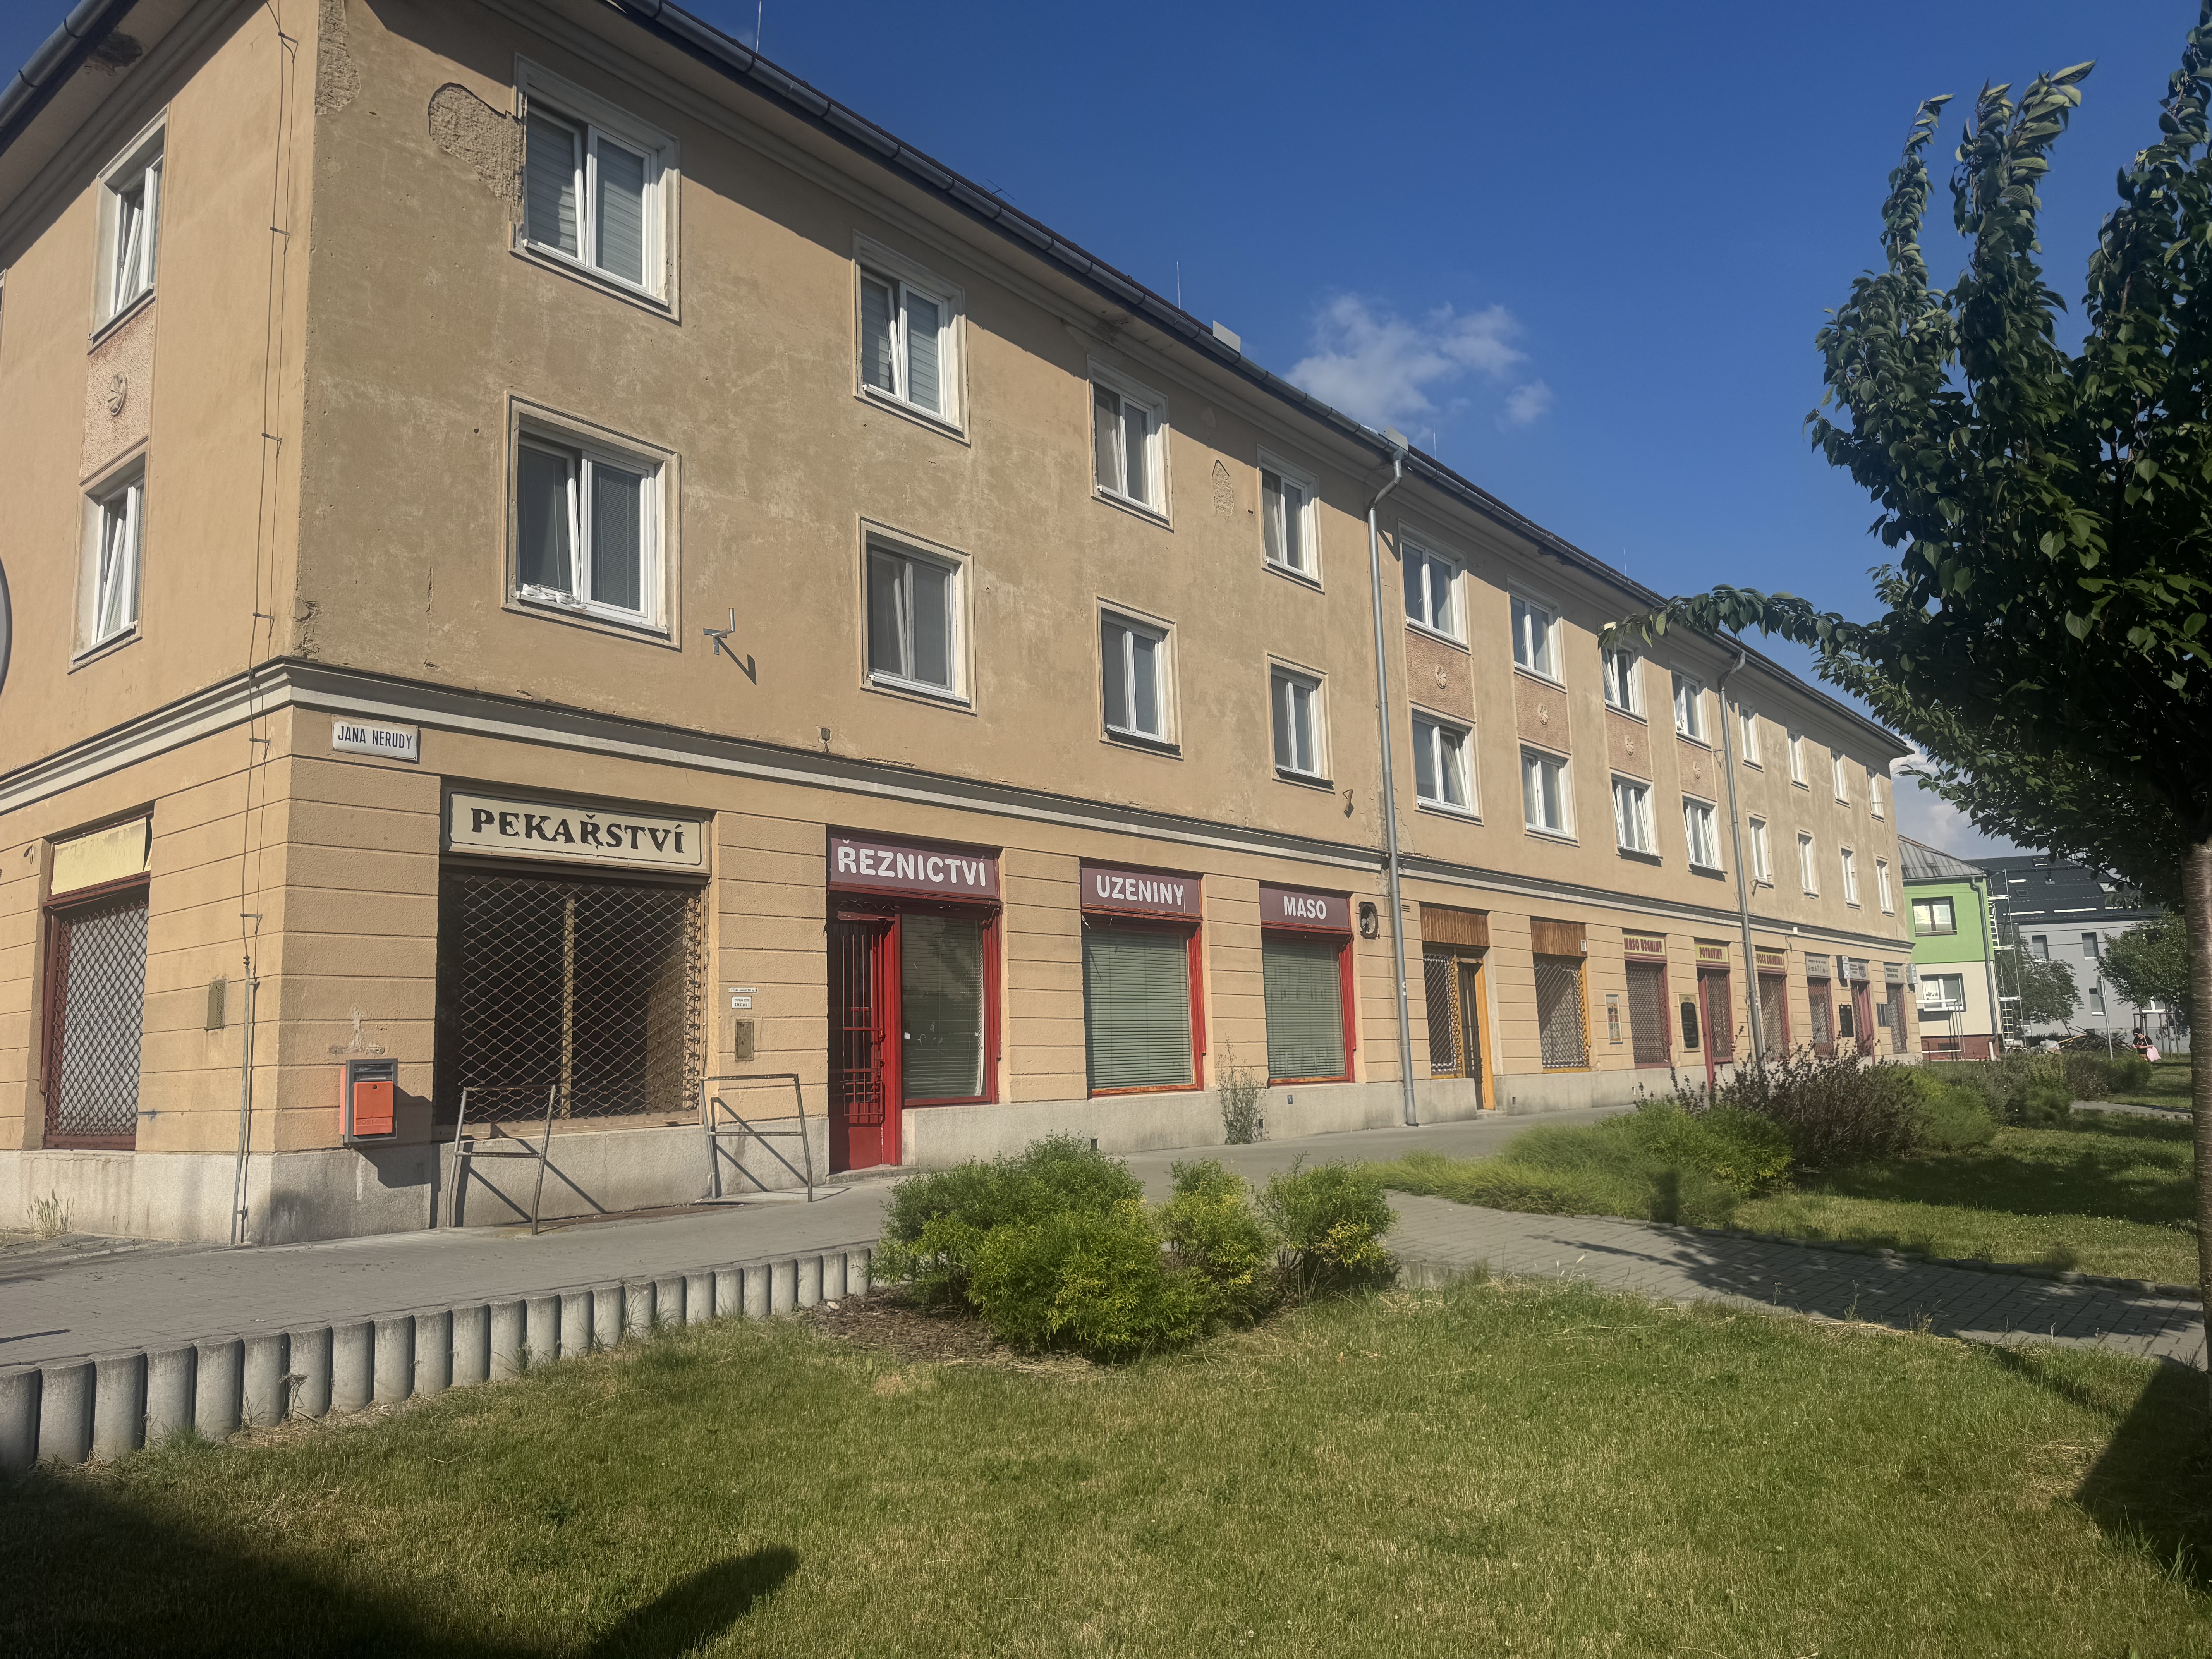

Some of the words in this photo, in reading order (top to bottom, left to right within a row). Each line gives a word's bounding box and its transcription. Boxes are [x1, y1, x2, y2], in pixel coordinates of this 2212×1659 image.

[338, 726, 366, 744] JANA
[373, 730, 412, 750] NERUDY
[471, 808, 684, 853] PEKAŘSTVÍ
[838, 838, 986, 886] ŘEZNICTVÍ
[1096, 875, 1184, 906] UZENINY
[1283, 895, 1327, 920] MASO
[1624, 937, 1640, 951] MASO
[1699, 946, 1722, 960] POTRAVINY
